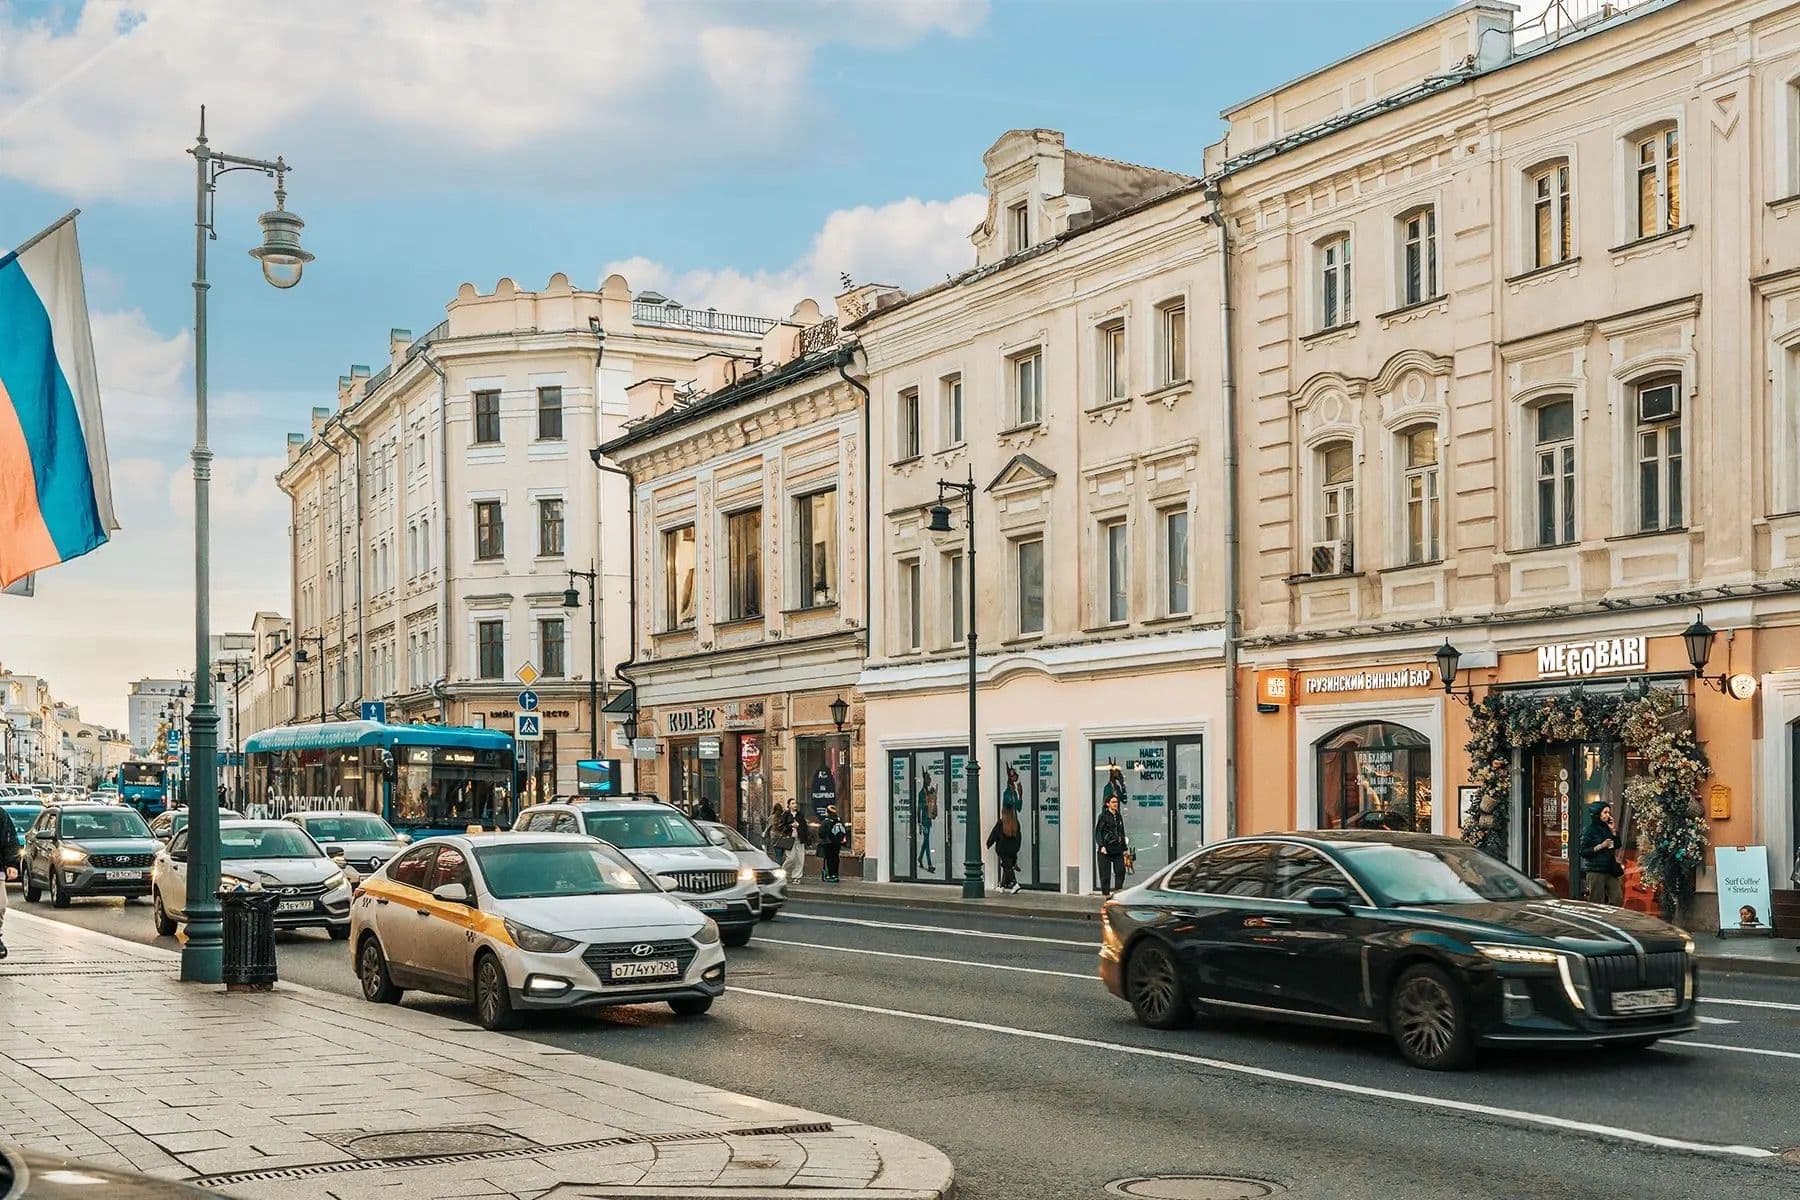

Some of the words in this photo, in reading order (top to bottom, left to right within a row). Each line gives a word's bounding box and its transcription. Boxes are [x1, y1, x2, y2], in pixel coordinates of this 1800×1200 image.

[1538, 637, 1645, 676] MEGOBARI
[1306, 671, 1365, 693] ГРУЗИНСКИЙ
[1365, 668, 1409, 690] ВИННЫЙ
[1409, 669, 1432, 687] БАР
[268, 785, 286, 818] Это
[1725, 877, 1739, 886] Surf
[658, 961, 676, 971] 790
